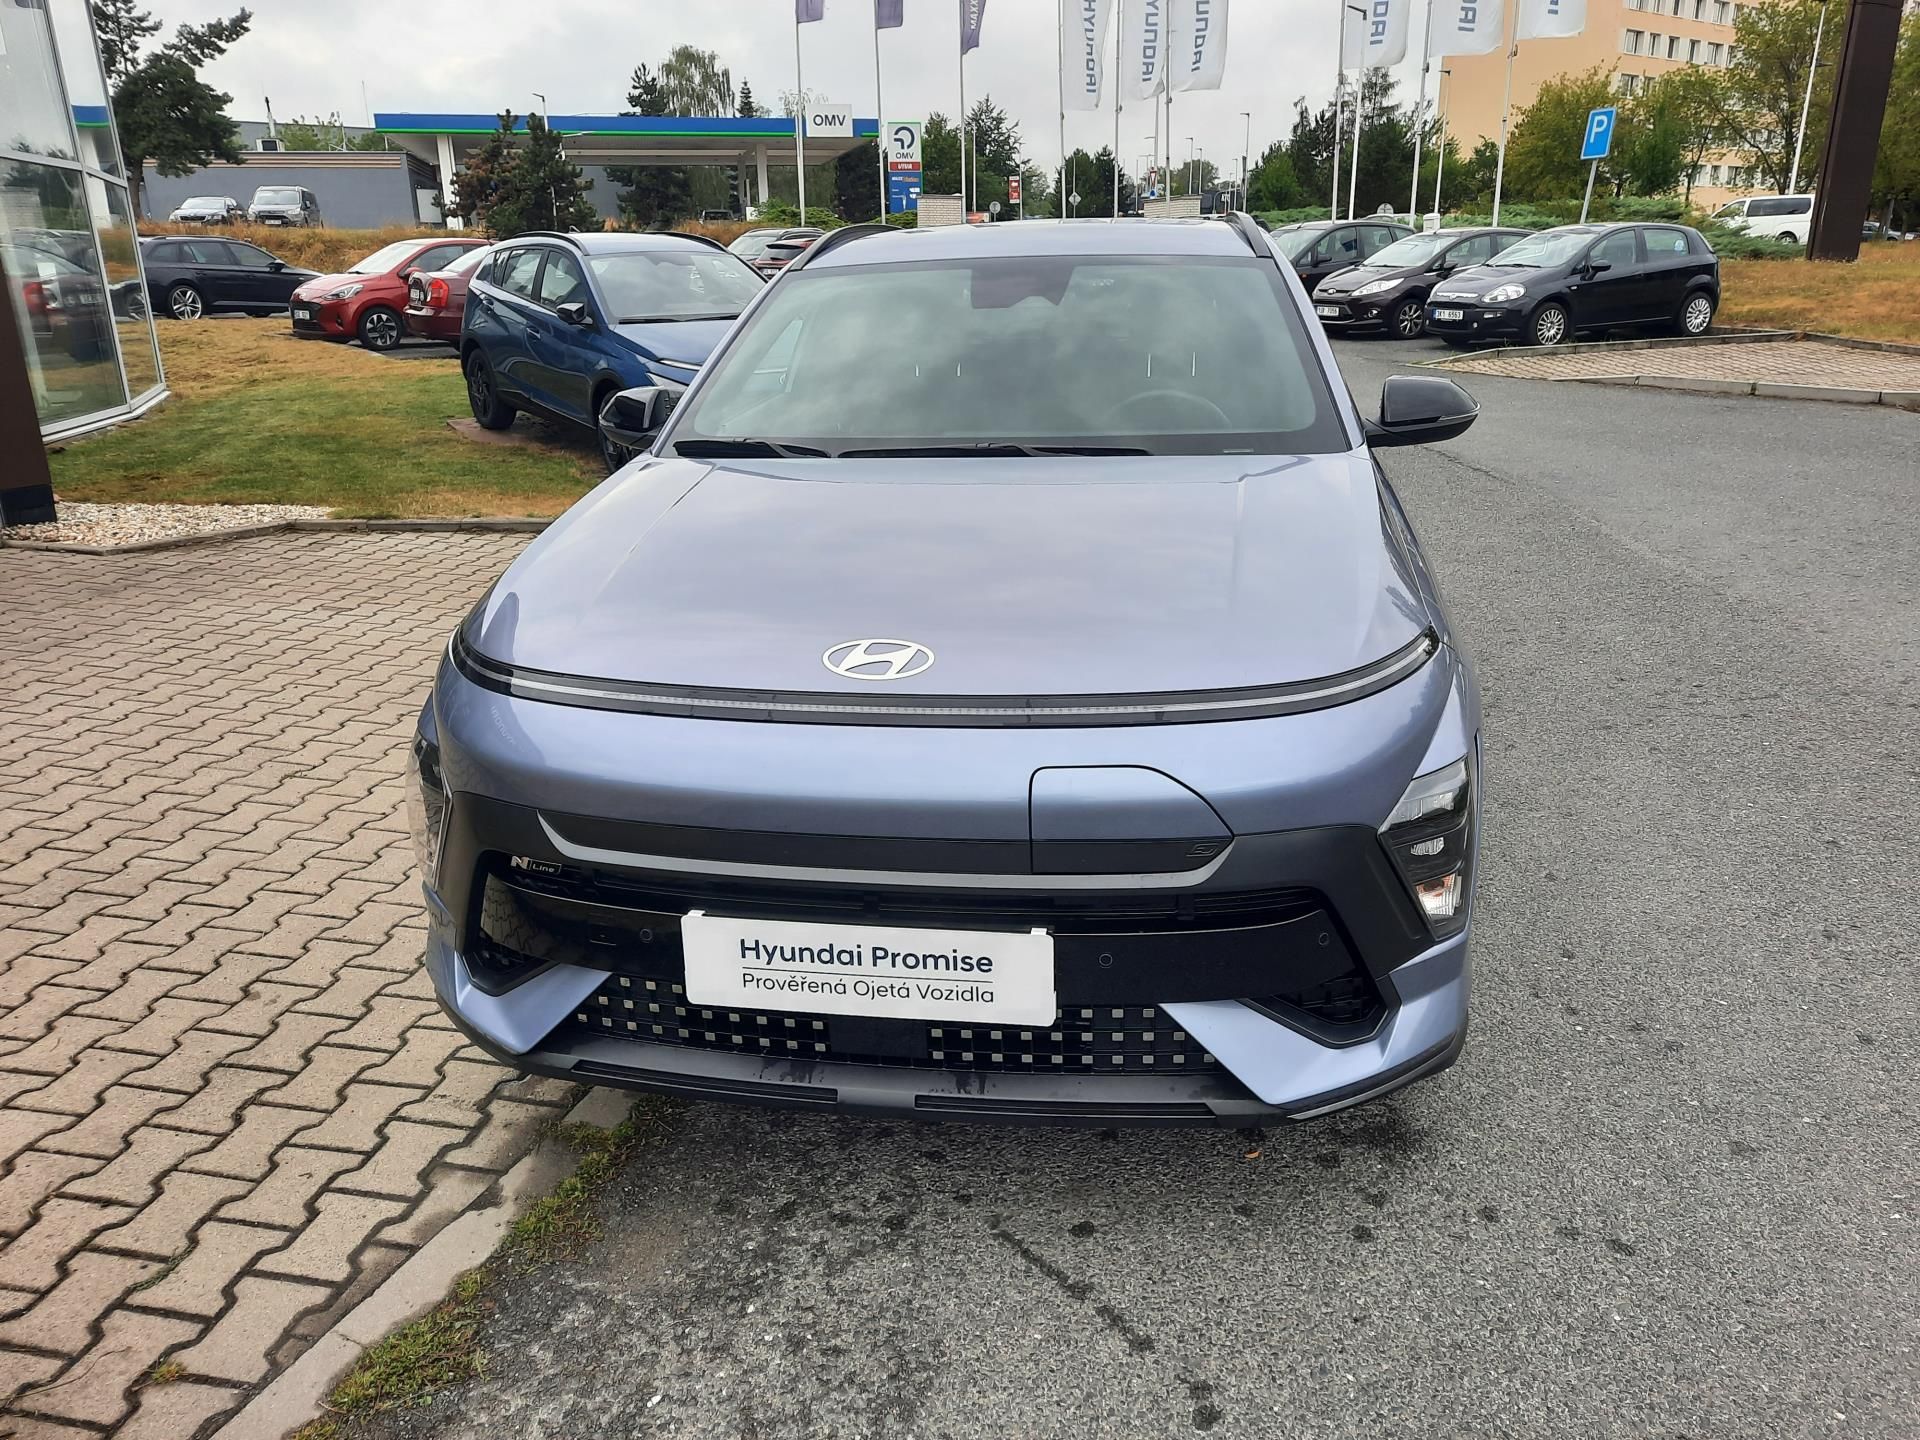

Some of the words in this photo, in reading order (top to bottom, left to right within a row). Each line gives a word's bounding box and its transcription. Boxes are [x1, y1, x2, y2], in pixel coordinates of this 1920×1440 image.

[1457, 0, 1478, 32] AI
[1082, 0, 1097, 93] HYUNDAI
[812, 114, 846, 127] OMV
[1589, 115, 1608, 144] P
[895, 152, 914, 160] OMV
[511, 855, 530, 870] N
[532, 863, 555, 873] Line
[740, 938, 862, 966] Hyundai
[872, 946, 993, 973] Promise
[742, 973, 847, 995] Prověřená
[853, 979, 910, 1001] Ojetá
[916, 984, 994, 1003] Vozidla
